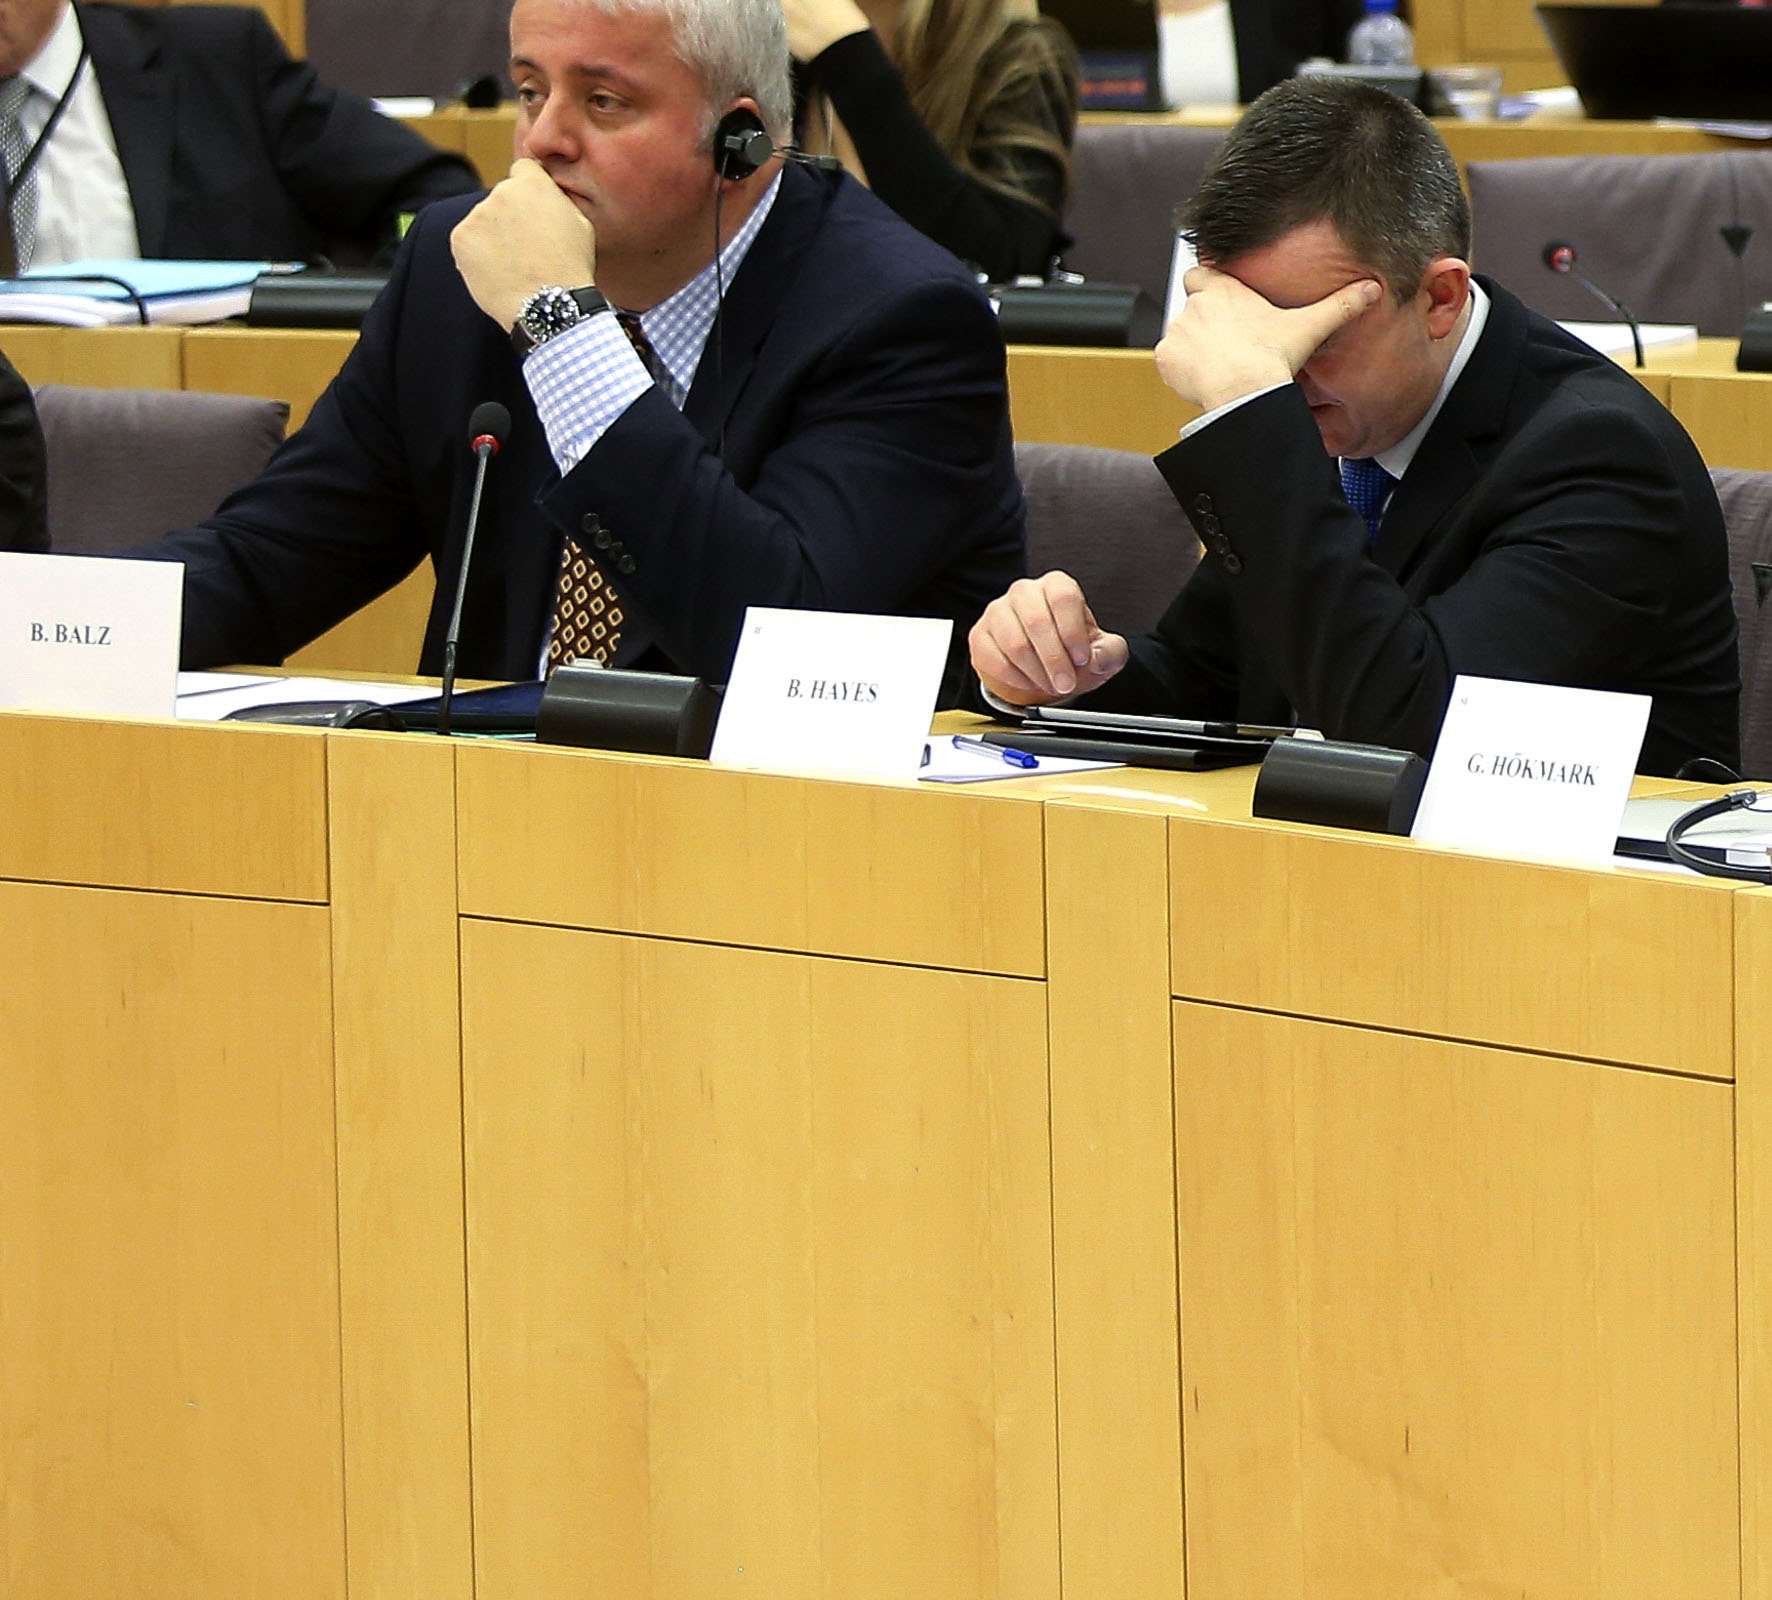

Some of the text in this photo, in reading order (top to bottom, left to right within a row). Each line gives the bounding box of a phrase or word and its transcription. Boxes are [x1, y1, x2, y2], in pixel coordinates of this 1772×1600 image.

[31, 622, 111, 646] B. BALZ
[787, 679, 879, 703] B. HAYES
[1467, 752, 1600, 786] G. HÖKMARK
